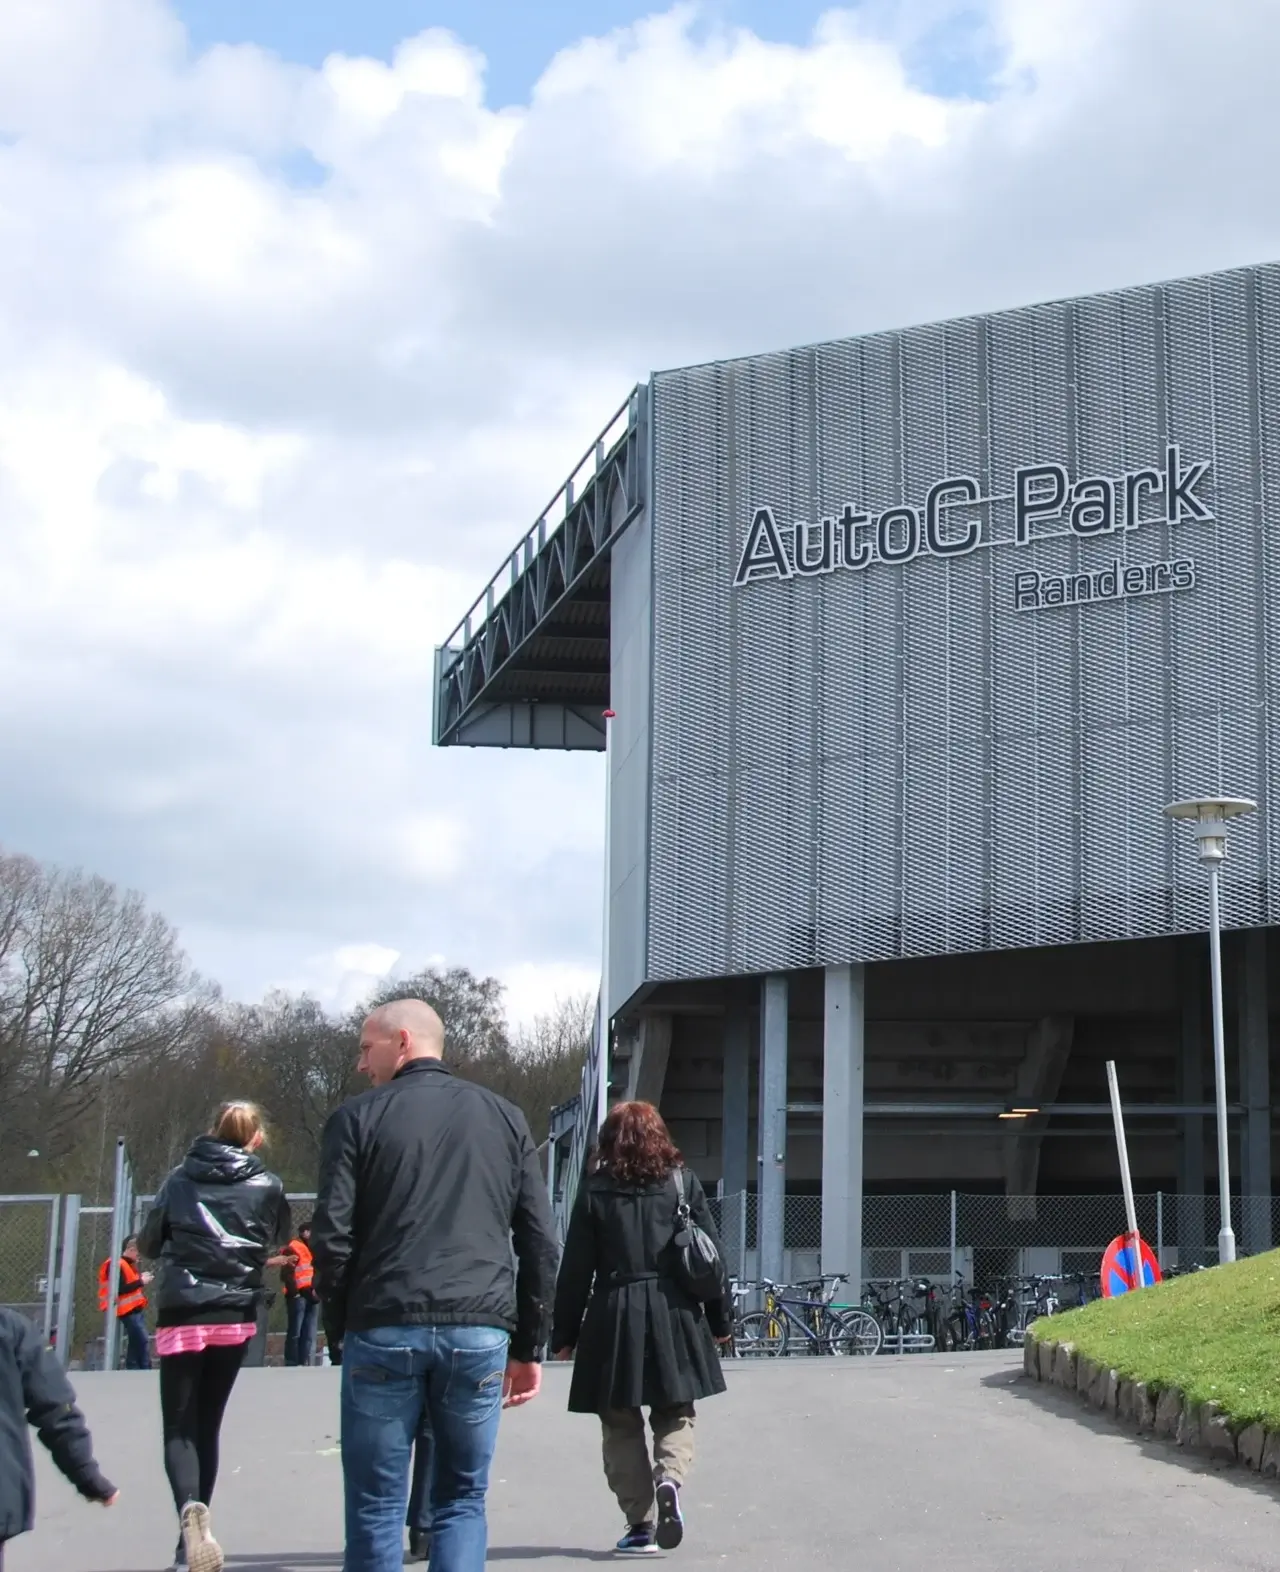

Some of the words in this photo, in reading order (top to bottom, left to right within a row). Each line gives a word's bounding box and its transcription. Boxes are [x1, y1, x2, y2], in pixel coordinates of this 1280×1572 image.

[734, 475, 982, 586] AutoC
[1014, 443, 1215, 547] Park
[1013, 557, 1196, 613] Randers
